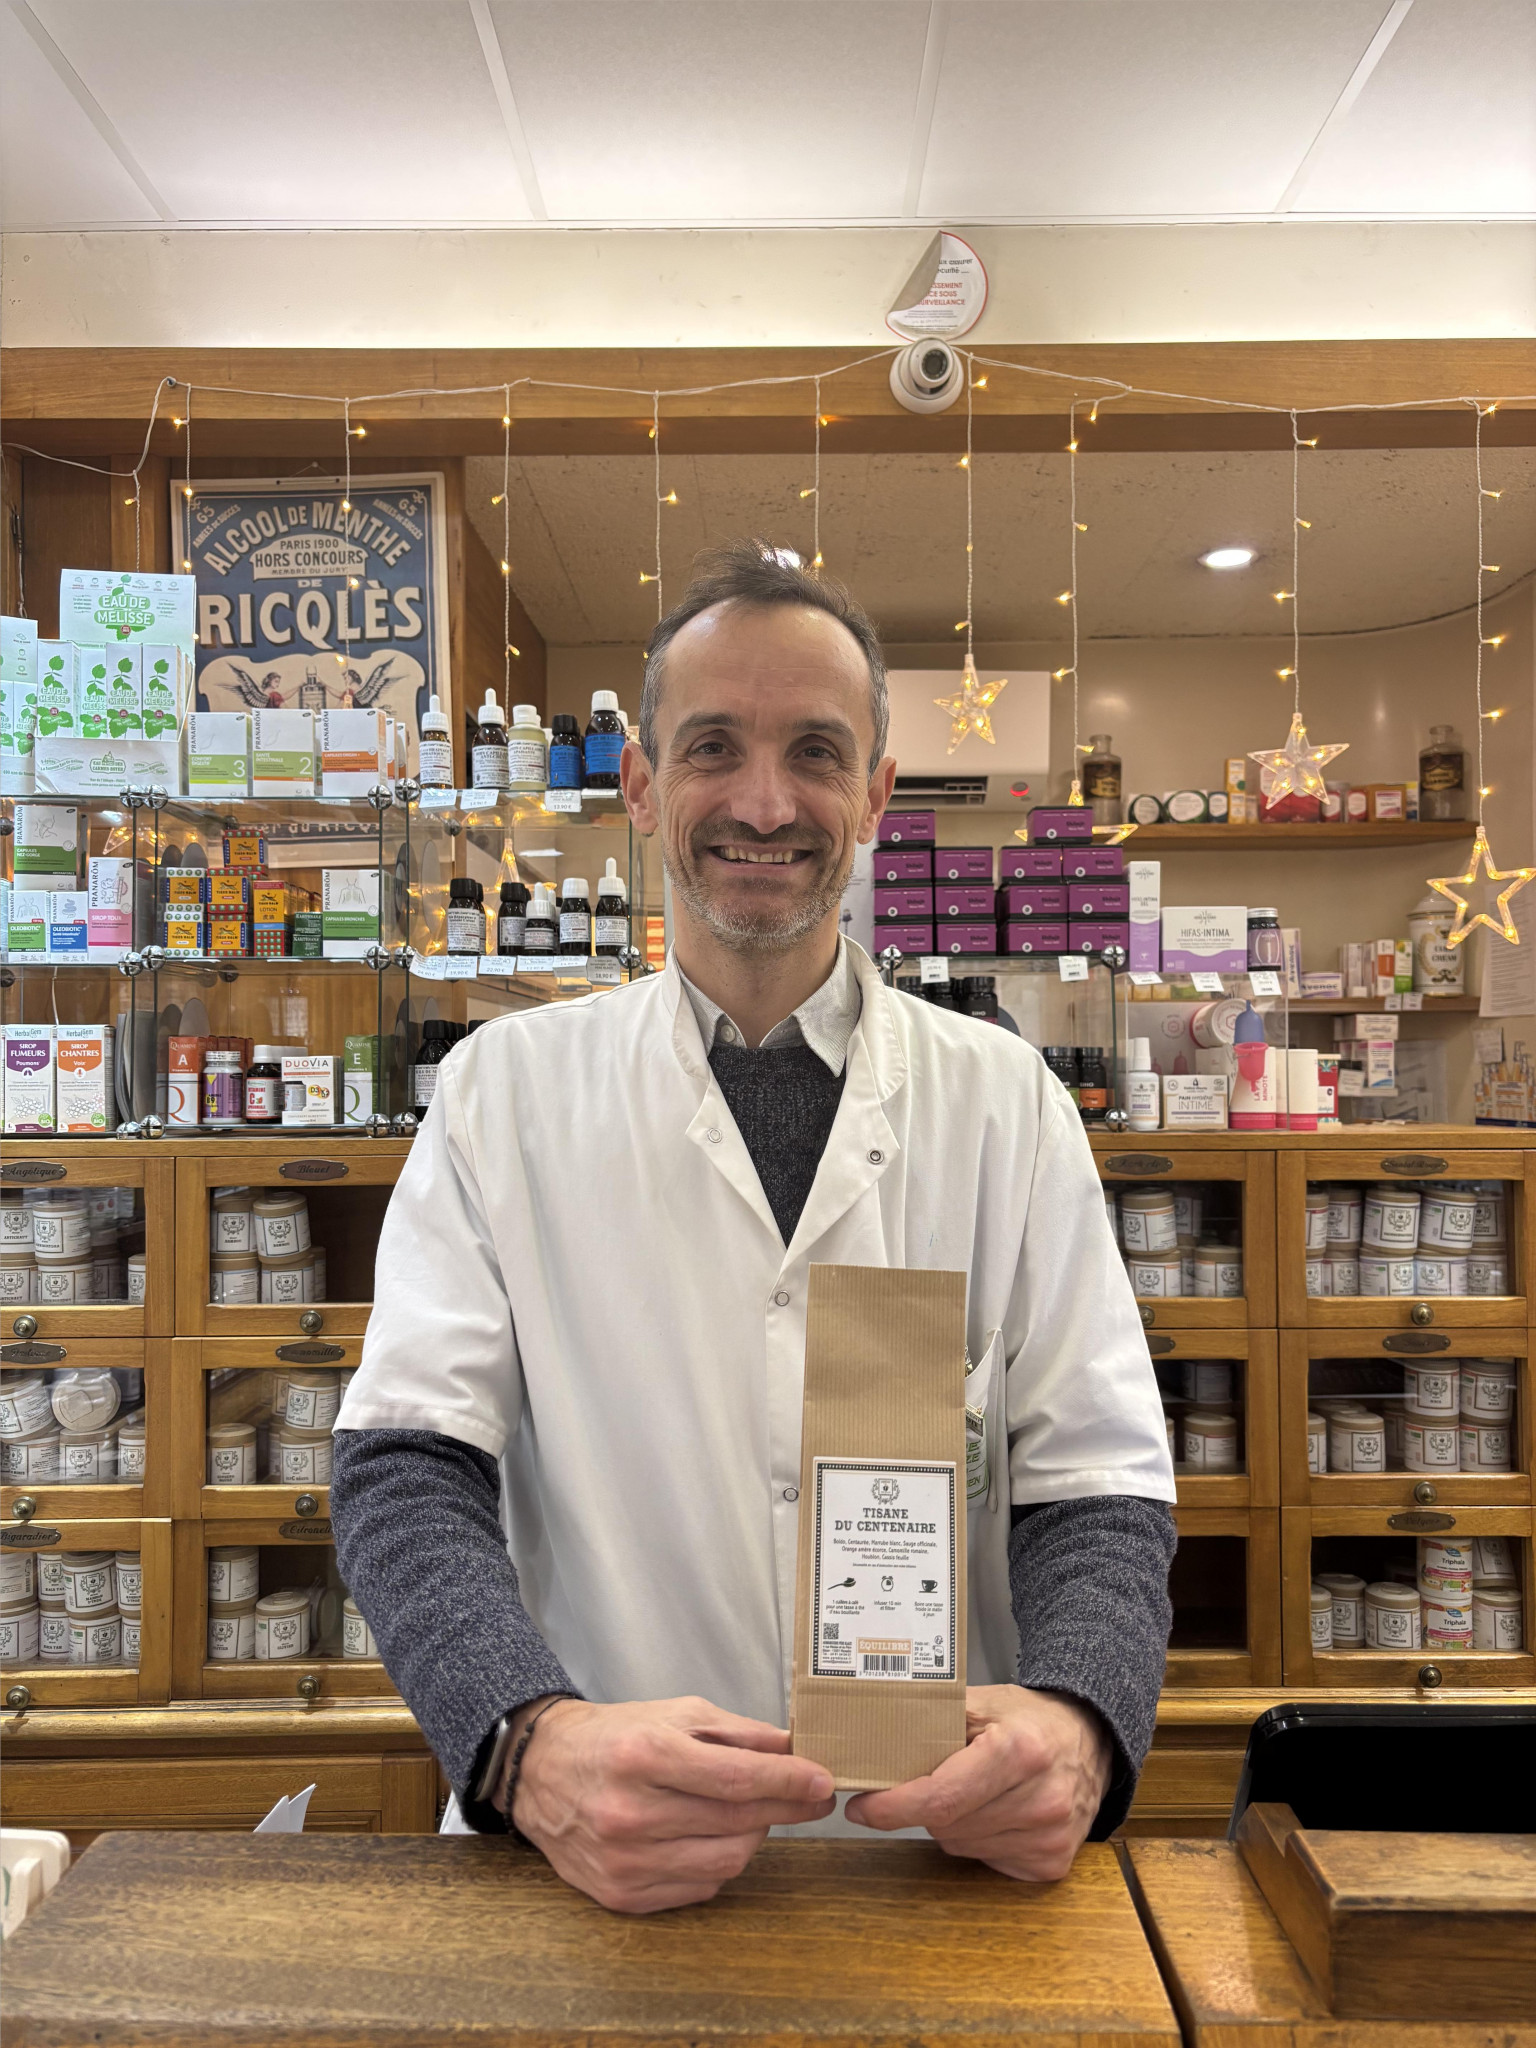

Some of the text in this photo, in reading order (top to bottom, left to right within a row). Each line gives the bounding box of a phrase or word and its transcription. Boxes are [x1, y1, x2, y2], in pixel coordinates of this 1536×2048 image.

[203, 501, 412, 576] ALCOOL DE MENTHE
[280, 538, 340, 550] PARIS 1900
[255, 550, 364, 568] HORS CONCOURS
[298, 580, 322, 588] DE
[102, 595, 128, 608] EAU
[129, 596, 147, 609] DE
[198, 580, 423, 650] RICQLÈS
[233, 760, 245, 778] 3
[300, 757, 312, 775] 2
[1181, 929, 1230, 937] HIFAS-INTIMA
[178, 1054, 188, 1065] A
[285, 1058, 329, 1068] DUOVIA
[354, 1053, 361, 1064] E
[250, 1093, 255, 1104] C
[1179, 1101, 1213, 1110] INTIME
[8, 1167, 57, 1177] Angélique
[863, 1508, 908, 1519] TISANE
[835, 1520, 936, 1533] DU CENTENAIRE
[1, 1531, 53, 1542] Bigaradier
[860, 1640, 910, 1651] ÉQUILIBRE
